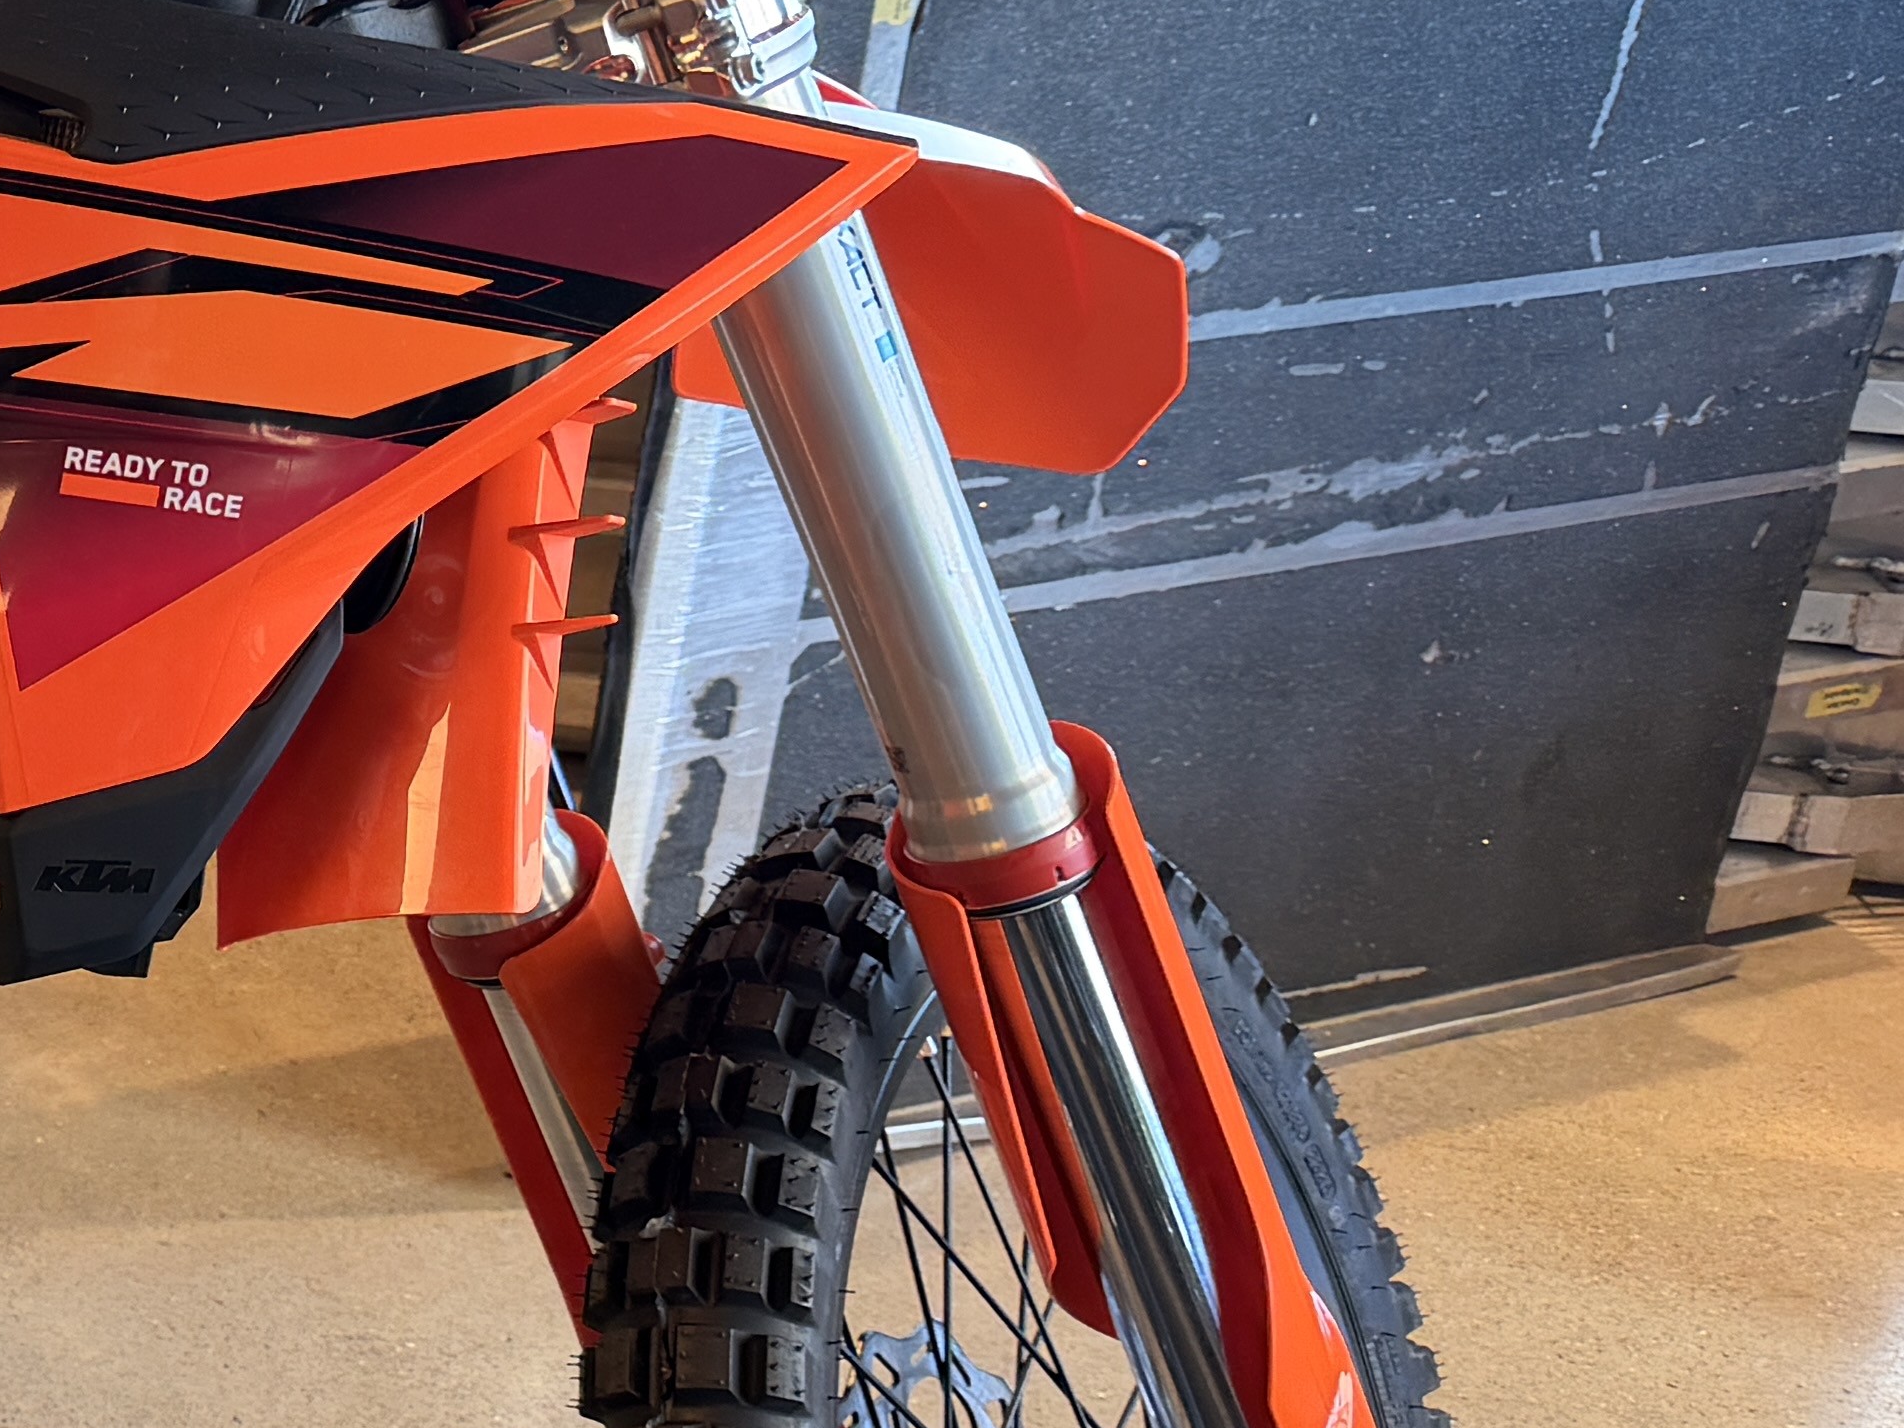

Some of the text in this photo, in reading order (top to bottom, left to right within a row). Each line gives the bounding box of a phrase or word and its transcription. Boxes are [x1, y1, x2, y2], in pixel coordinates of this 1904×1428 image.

[63, 444, 210, 487] READY TO
[162, 486, 244, 520] RACE
[32, 858, 160, 895] KTM
